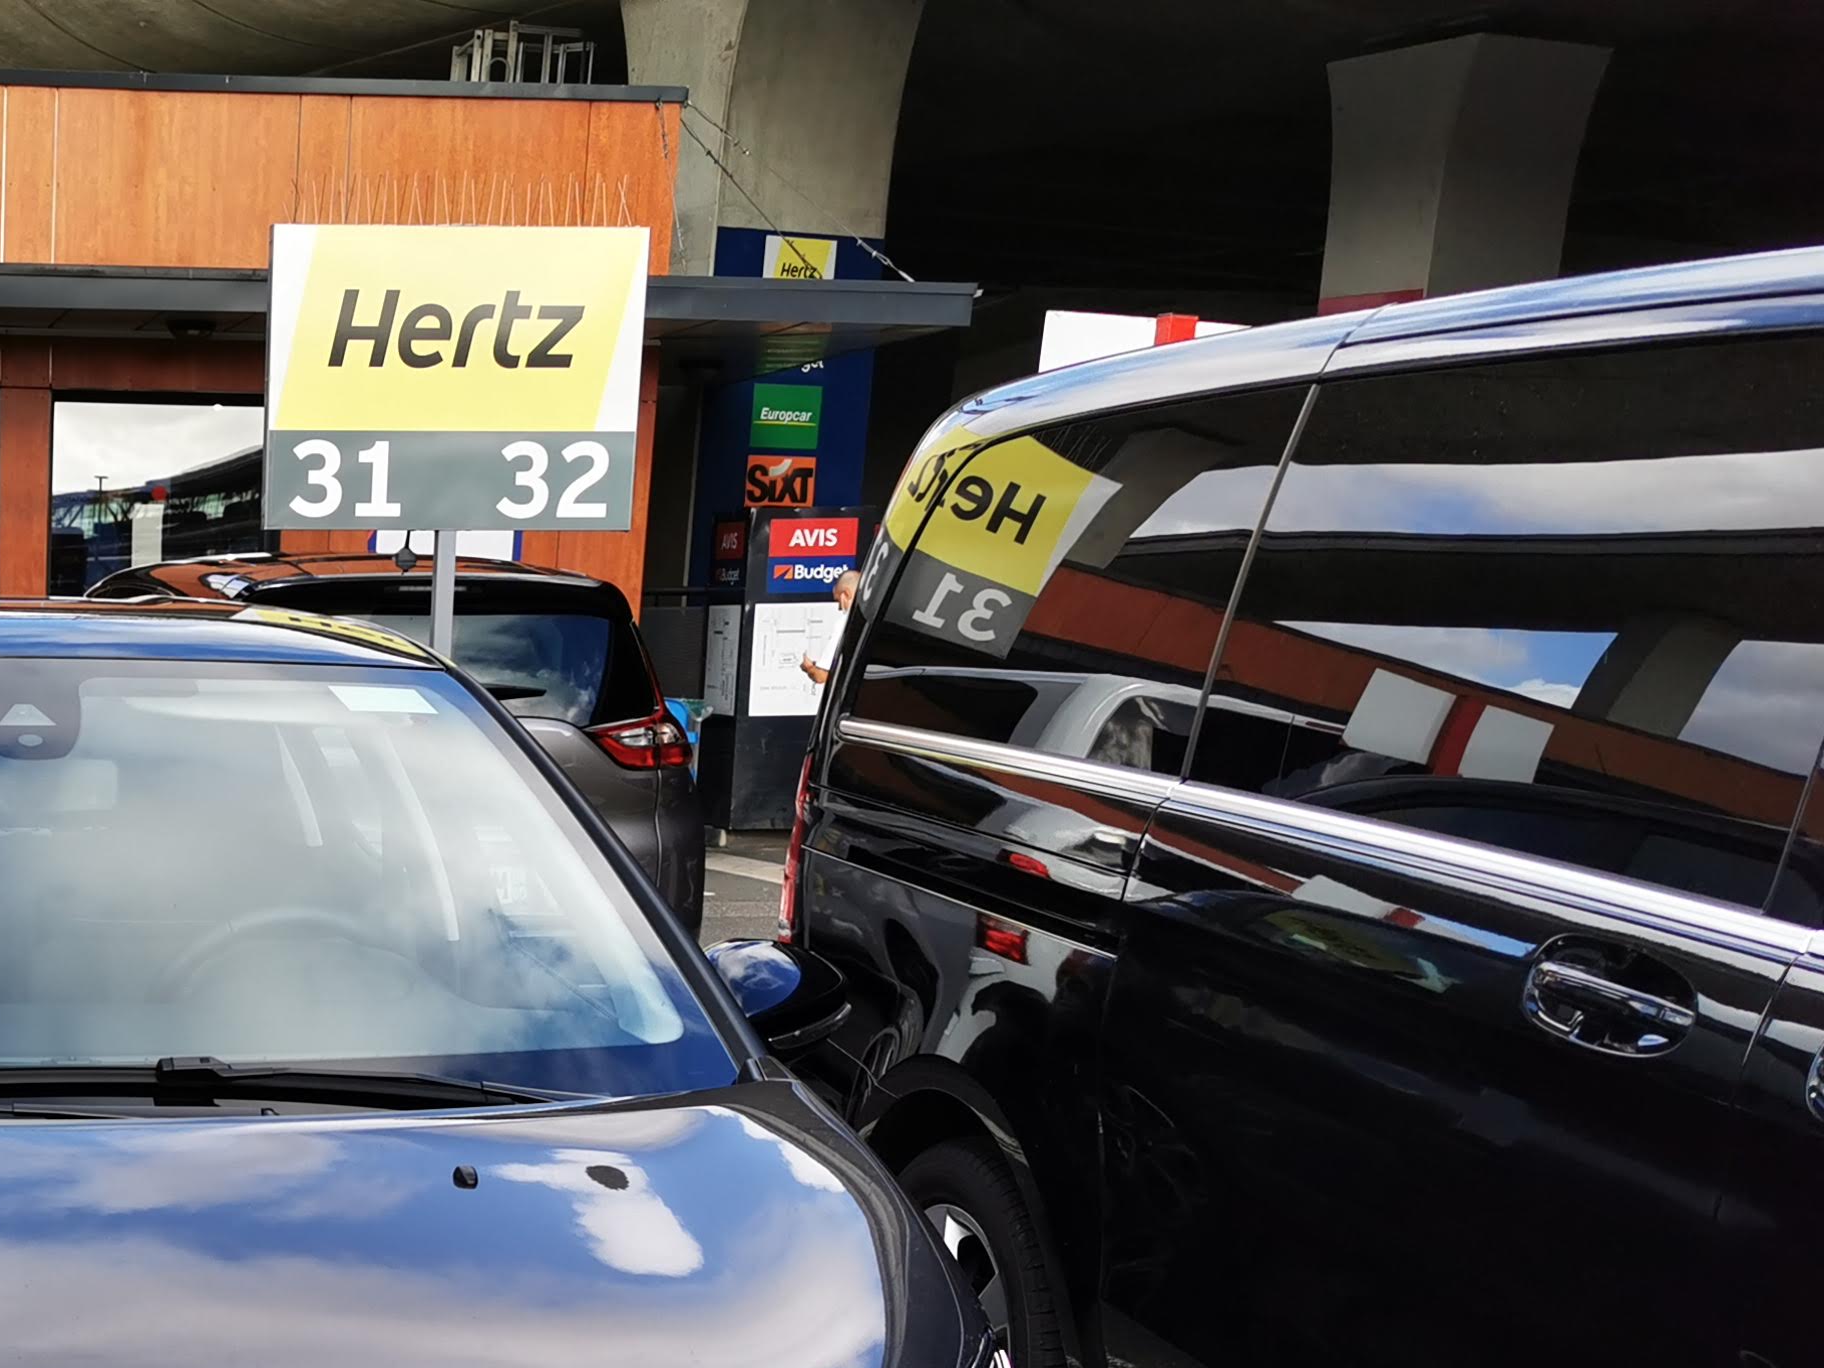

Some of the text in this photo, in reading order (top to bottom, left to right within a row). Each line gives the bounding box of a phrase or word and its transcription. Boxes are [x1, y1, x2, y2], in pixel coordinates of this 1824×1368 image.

[780, 263, 818, 279] Hertz
[328, 289, 585, 369] Hertz
[760, 407, 812, 424] Europcar
[289, 439, 610, 520] 31 32
[788, 528, 838, 547] AVIS
